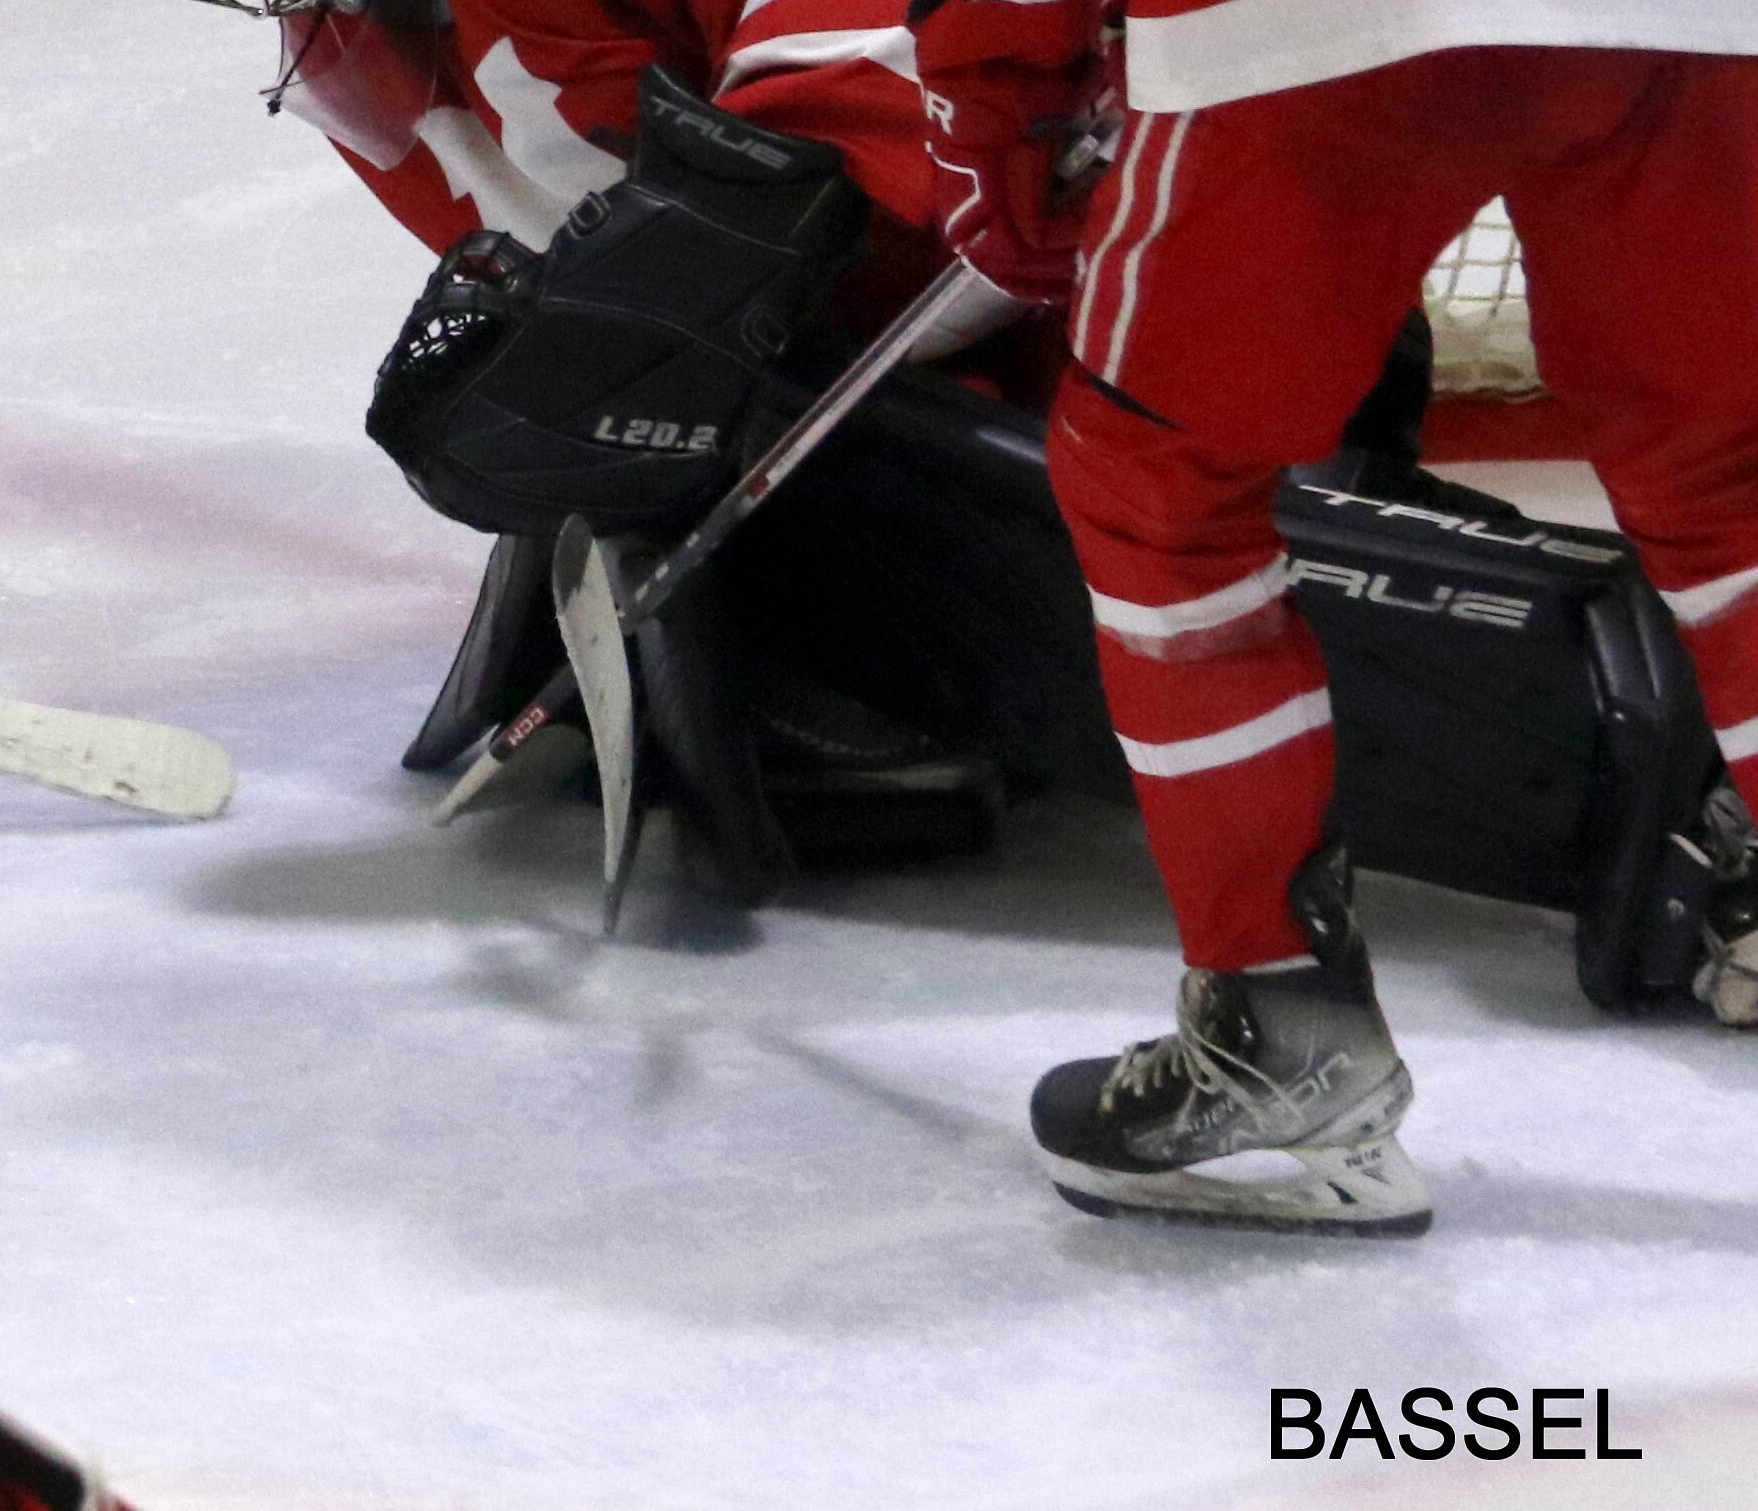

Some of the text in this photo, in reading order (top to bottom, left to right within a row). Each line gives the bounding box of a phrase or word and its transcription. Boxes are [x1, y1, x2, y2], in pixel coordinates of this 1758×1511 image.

[650, 94, 792, 171] TRUE
[594, 415, 719, 451] L20.2
[1298, 483, 1625, 564] TRUE
[1286, 556, 1533, 629] RUE
